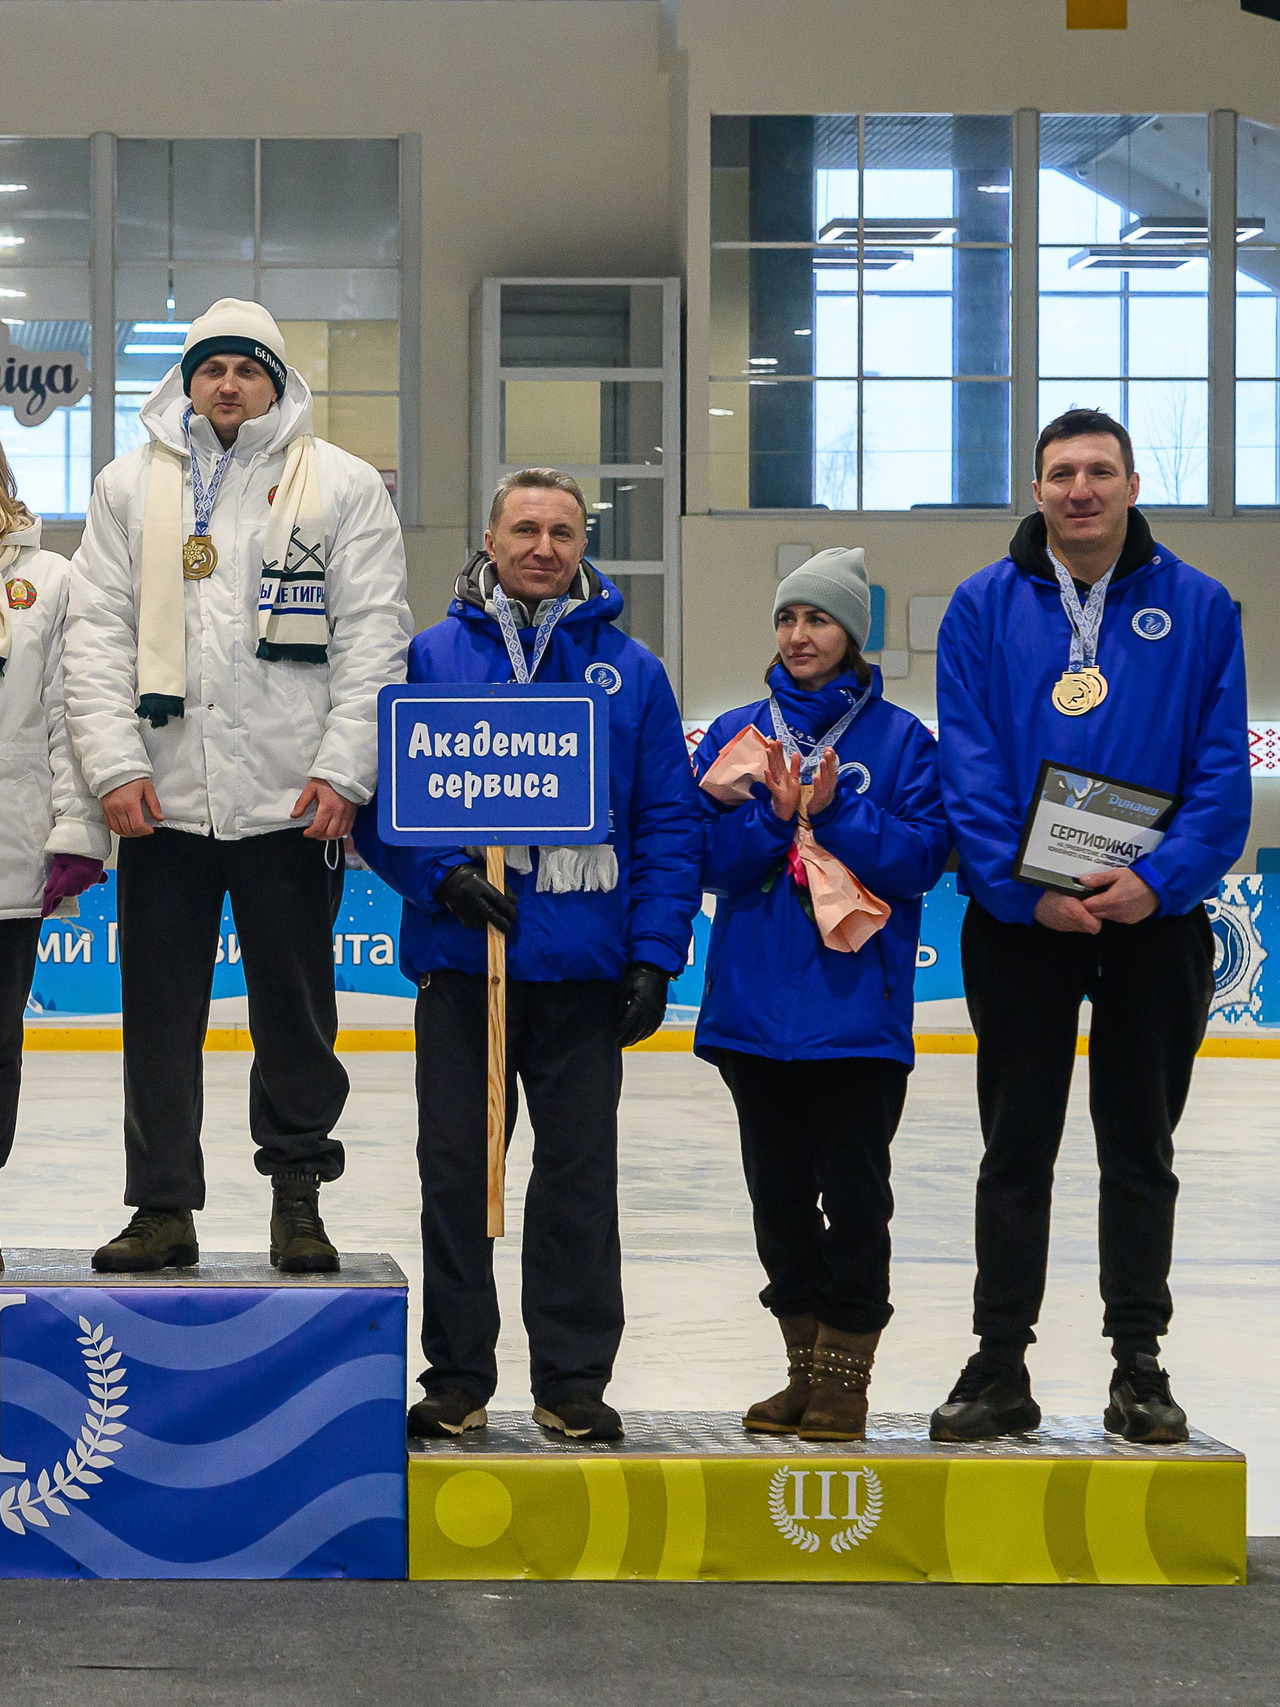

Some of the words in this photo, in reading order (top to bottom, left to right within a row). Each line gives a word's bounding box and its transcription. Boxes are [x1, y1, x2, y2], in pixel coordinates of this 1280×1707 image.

[408, 720, 578, 759] Академия
[428, 770, 559, 809] сервиса
[1050, 823, 1143, 860] СЕРТИФИКАТ
[789, 1471, 865, 1520] III
